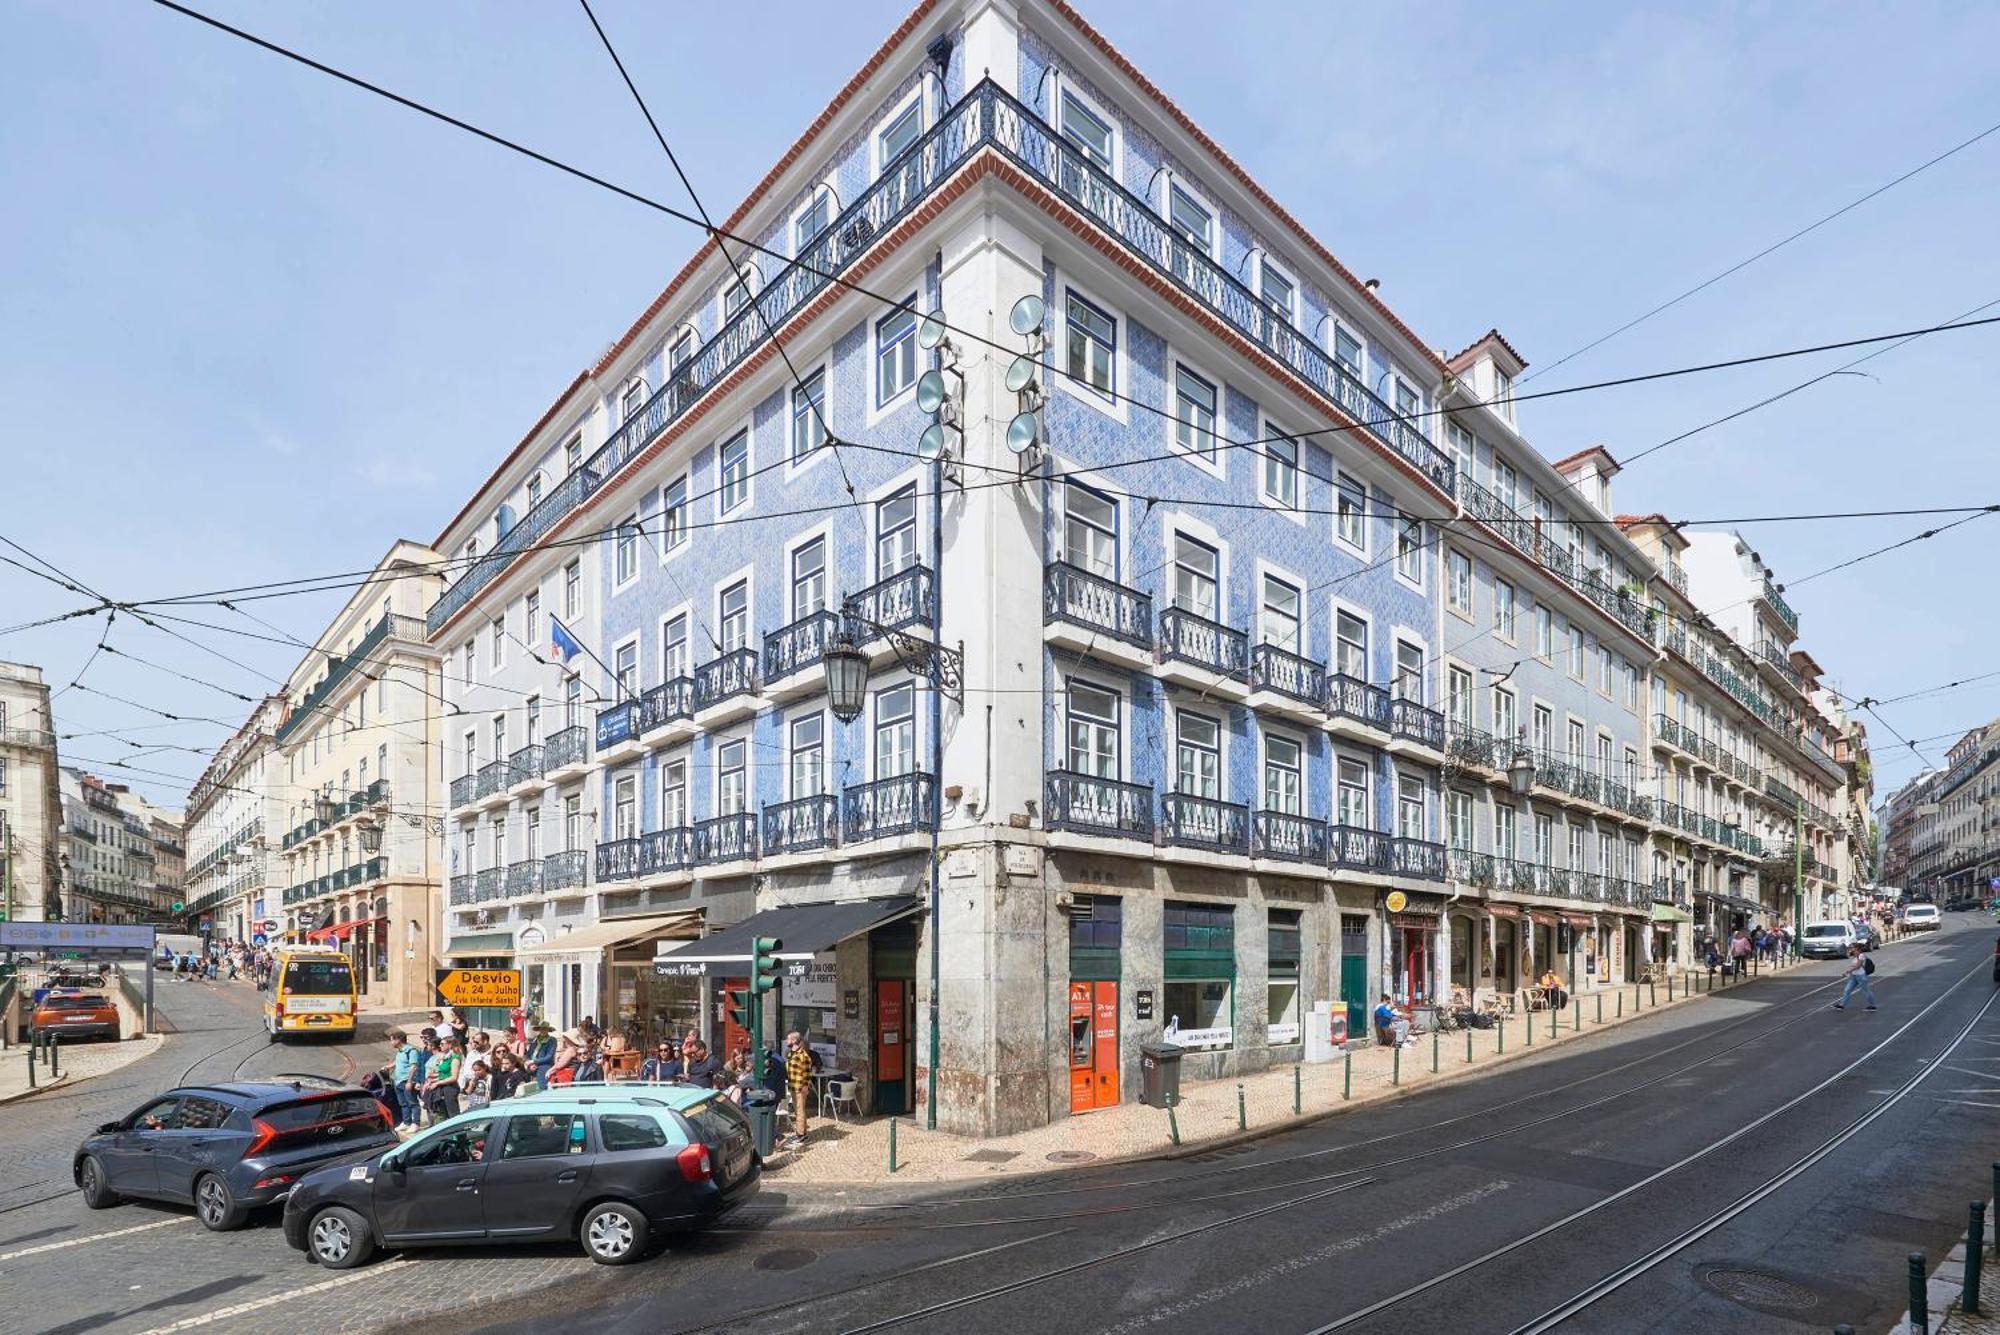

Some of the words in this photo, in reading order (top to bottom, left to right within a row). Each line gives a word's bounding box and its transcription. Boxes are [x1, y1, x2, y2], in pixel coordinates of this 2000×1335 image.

[461, 971, 512, 984] Desvio
[455, 985, 469, 994] Av.
[471, 985, 484, 994] 24
[495, 985, 518, 995] Julho
[1071, 991, 1090, 1001] ATM
